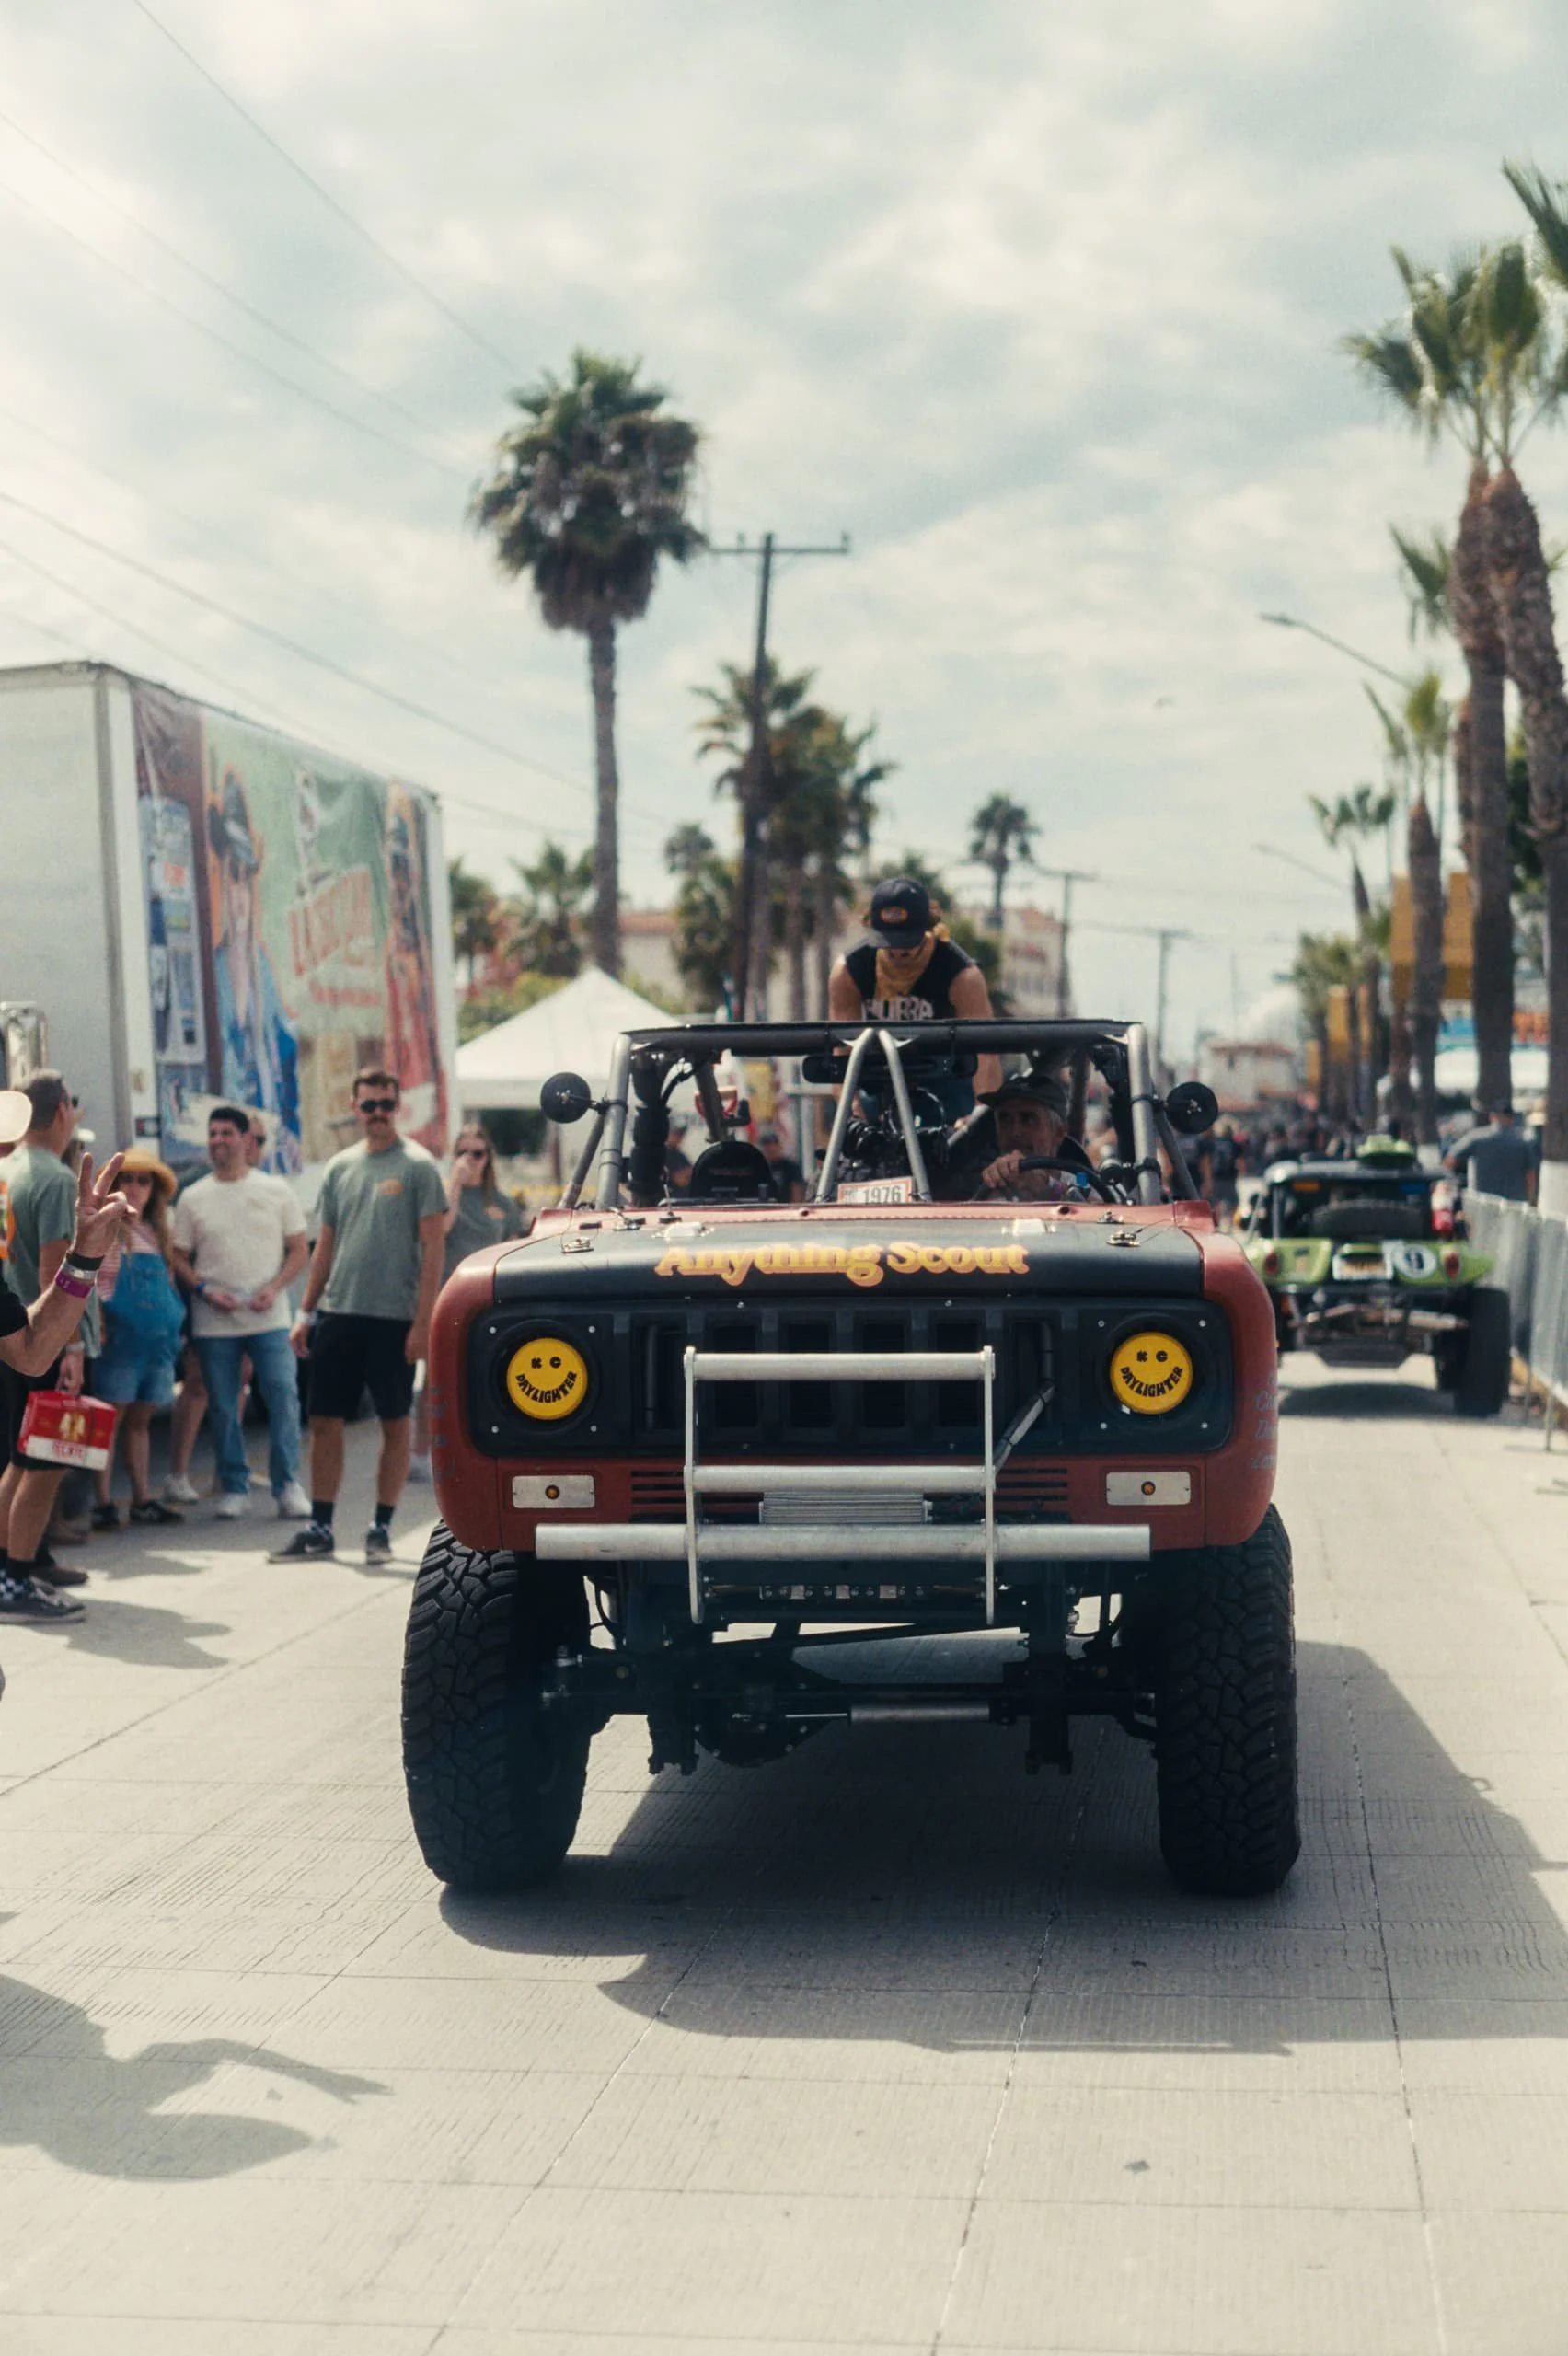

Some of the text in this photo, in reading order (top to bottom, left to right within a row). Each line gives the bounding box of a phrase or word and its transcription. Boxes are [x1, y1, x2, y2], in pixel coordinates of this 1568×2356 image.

[864, 1185, 902, 1204] 1976
[653, 1241, 1030, 1287] Anything Scout
[515, 1370, 577, 1403] DAYLIGHTER
[1120, 1366, 1183, 1397] DAYLIGHTER
